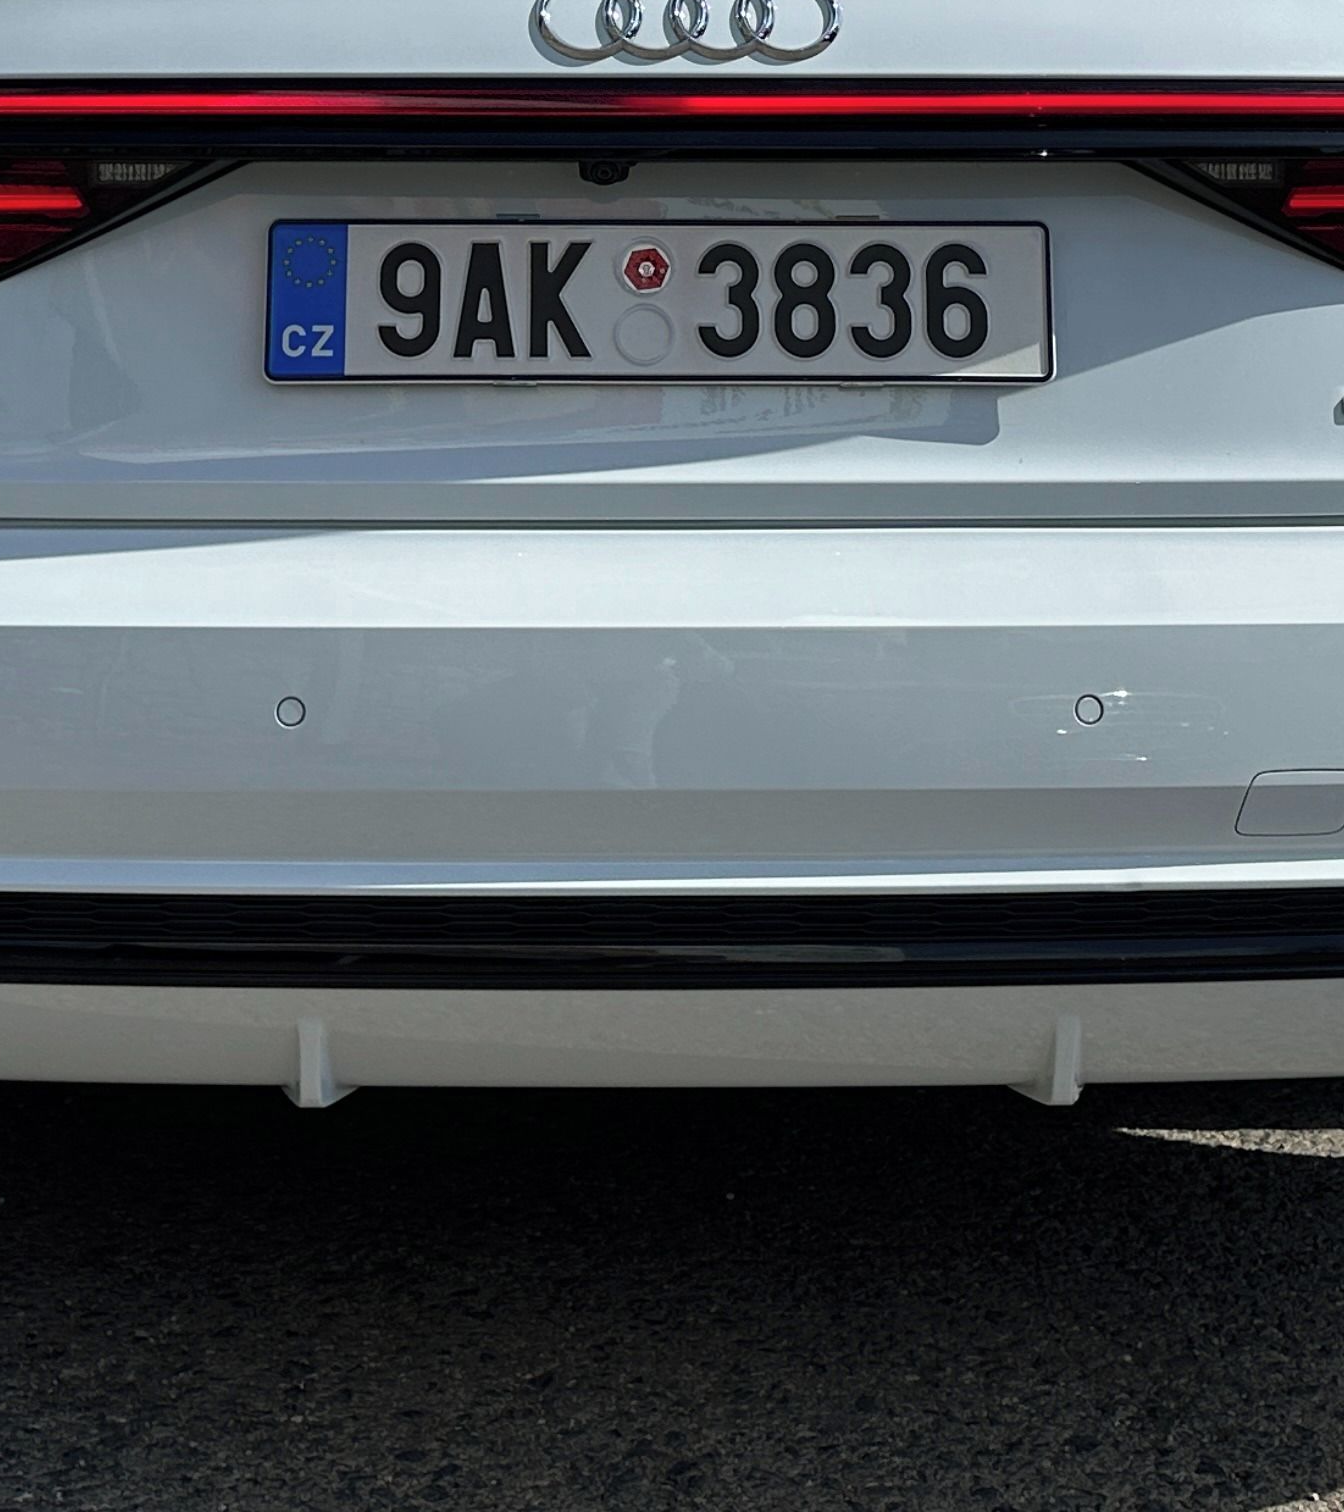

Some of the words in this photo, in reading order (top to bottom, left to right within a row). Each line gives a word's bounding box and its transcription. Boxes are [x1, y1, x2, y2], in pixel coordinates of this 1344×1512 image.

[378, 242, 594, 359] 9AK
[697, 242, 989, 360] 3836
[282, 324, 334, 357] CZ
